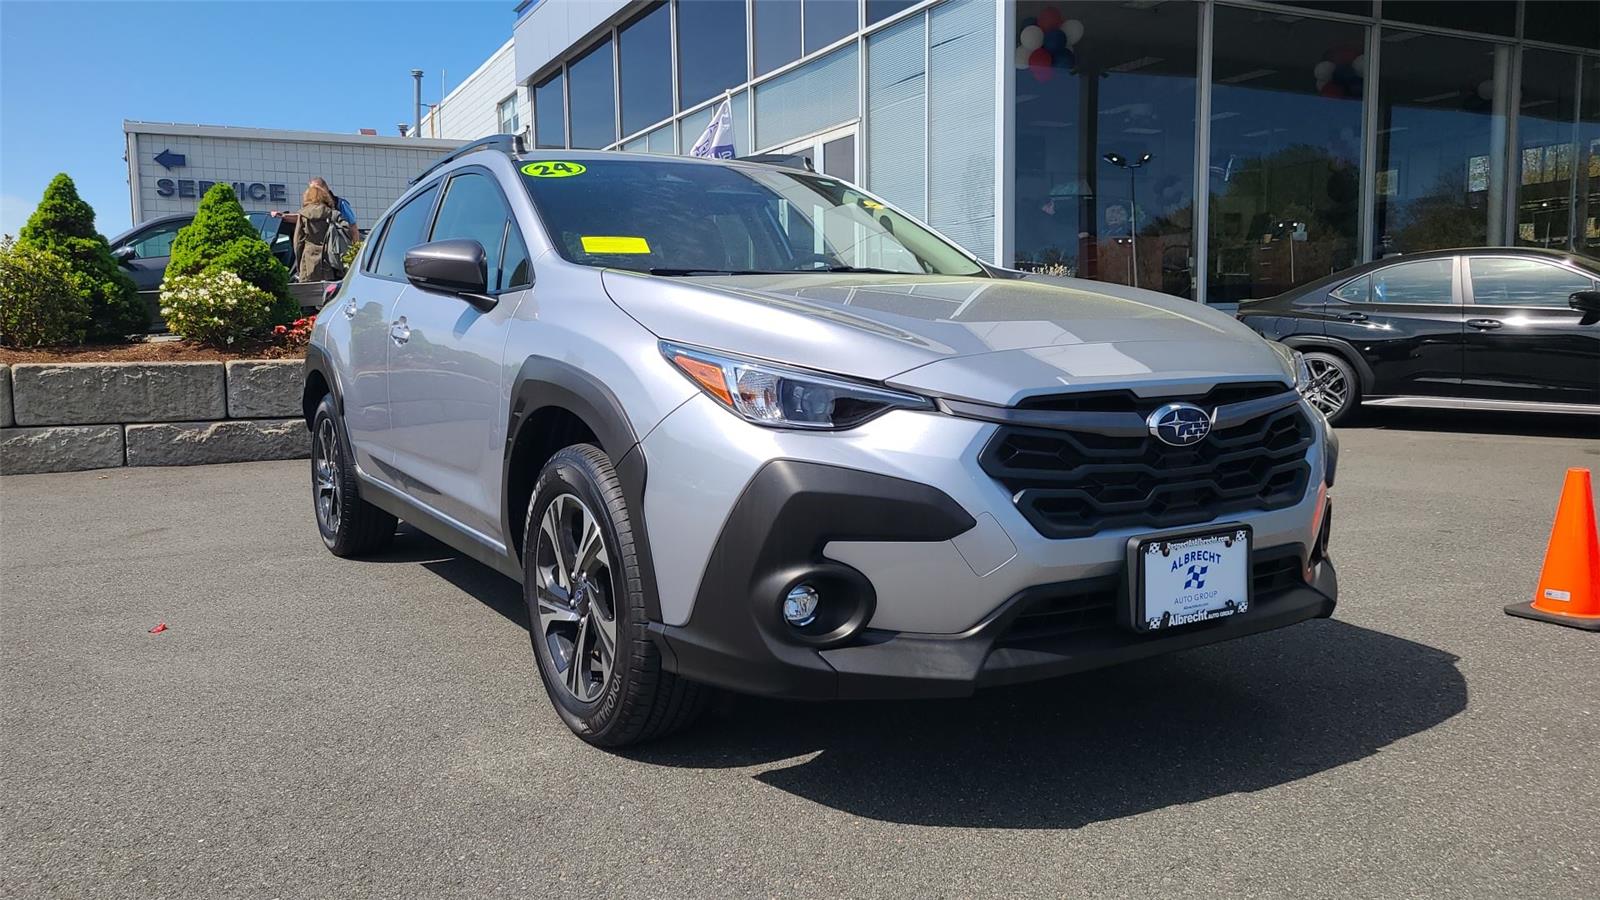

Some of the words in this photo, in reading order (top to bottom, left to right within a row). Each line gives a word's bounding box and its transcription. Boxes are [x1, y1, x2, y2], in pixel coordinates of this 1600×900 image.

[534, 163, 572, 175] 24
[157, 179, 286, 202] SERICE
[1171, 551, 1221, 572] ALBRECHT
[1174, 594, 1193, 605] AUTO
[1194, 590, 1218, 601] GROUP
[1168, 609, 1208, 627] Albrecht
[1208, 612, 1219, 620] AUTO
